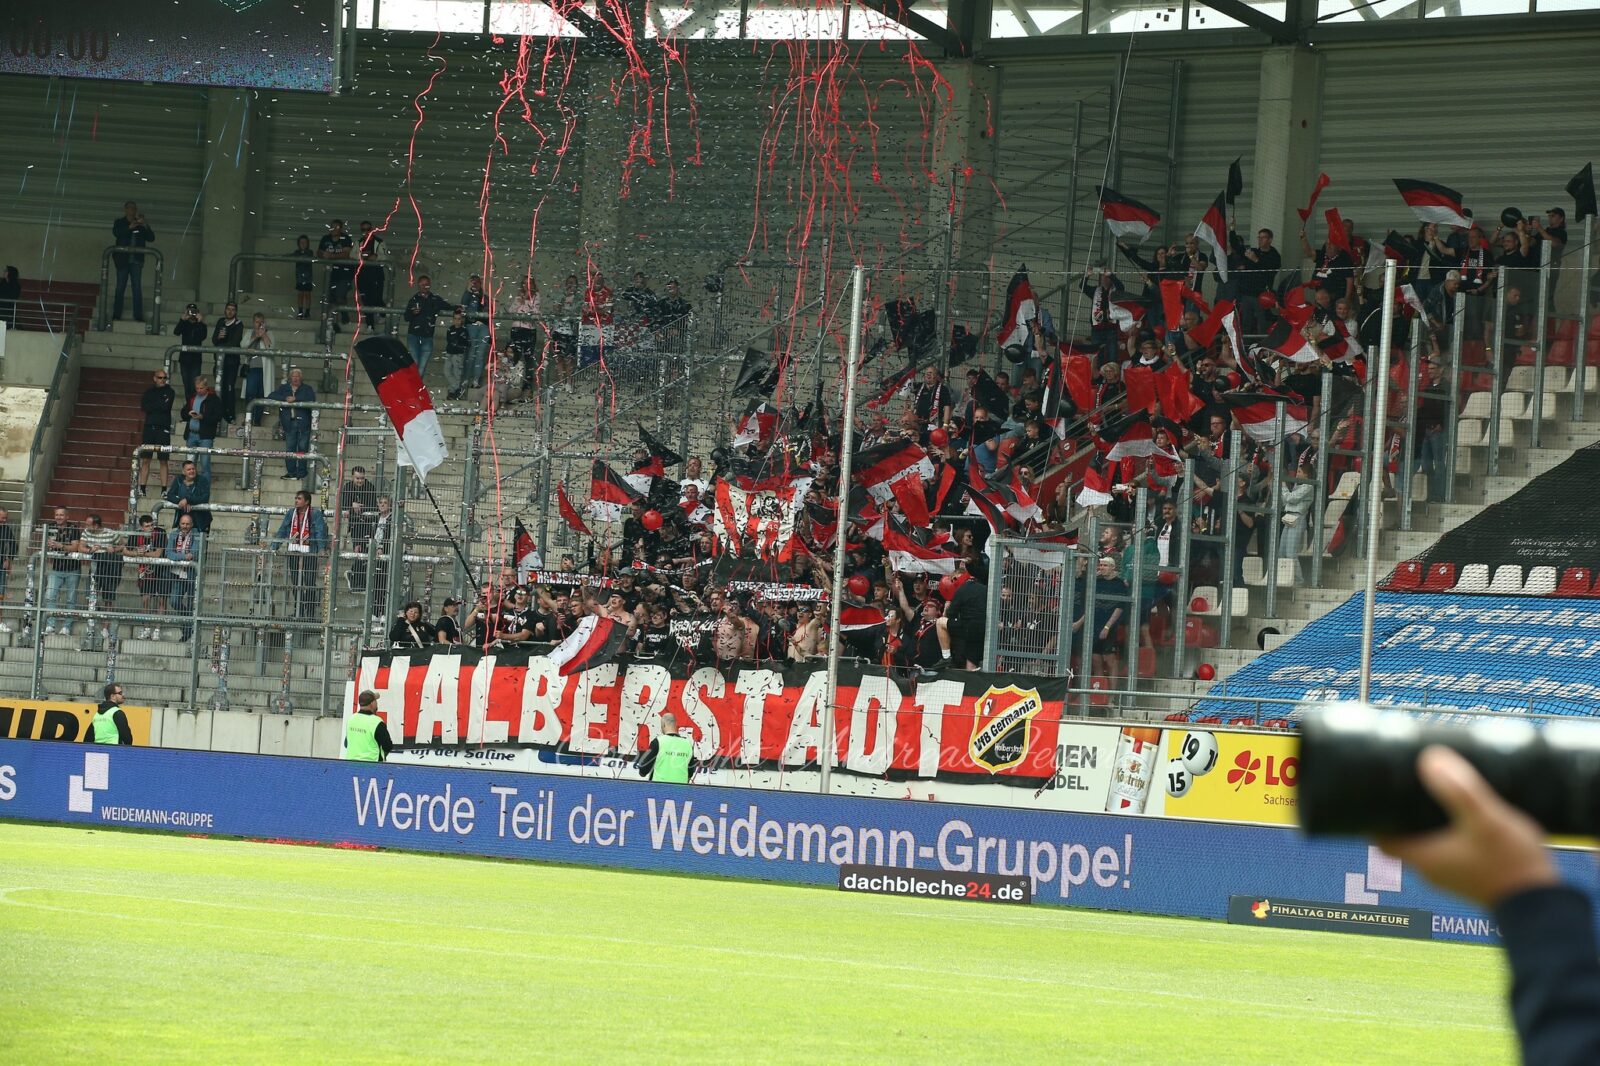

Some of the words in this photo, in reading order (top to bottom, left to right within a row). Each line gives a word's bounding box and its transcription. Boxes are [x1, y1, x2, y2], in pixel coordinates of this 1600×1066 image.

[355, 653, 965, 778] HALBERSTADT
[973, 731, 992, 753] VfB
[990, 699, 1037, 738] Germania
[464, 748, 516, 761] Saline
[1182, 733, 1200, 761] 19
[1168, 771, 1186, 792] 15
[101, 805, 213, 829] WEIDEMANN-GRUPPE
[352, 775, 476, 836] Werde
[490, 785, 554, 841] Teil
[568, 793, 635, 847] der
[646, 797, 1133, 898] Weidemann-Gruppe!
[1271, 905, 1324, 918] FINALTAG
[1326, 910, 1348, 920] DER
[1351, 912, 1410, 926] AMATEURE
